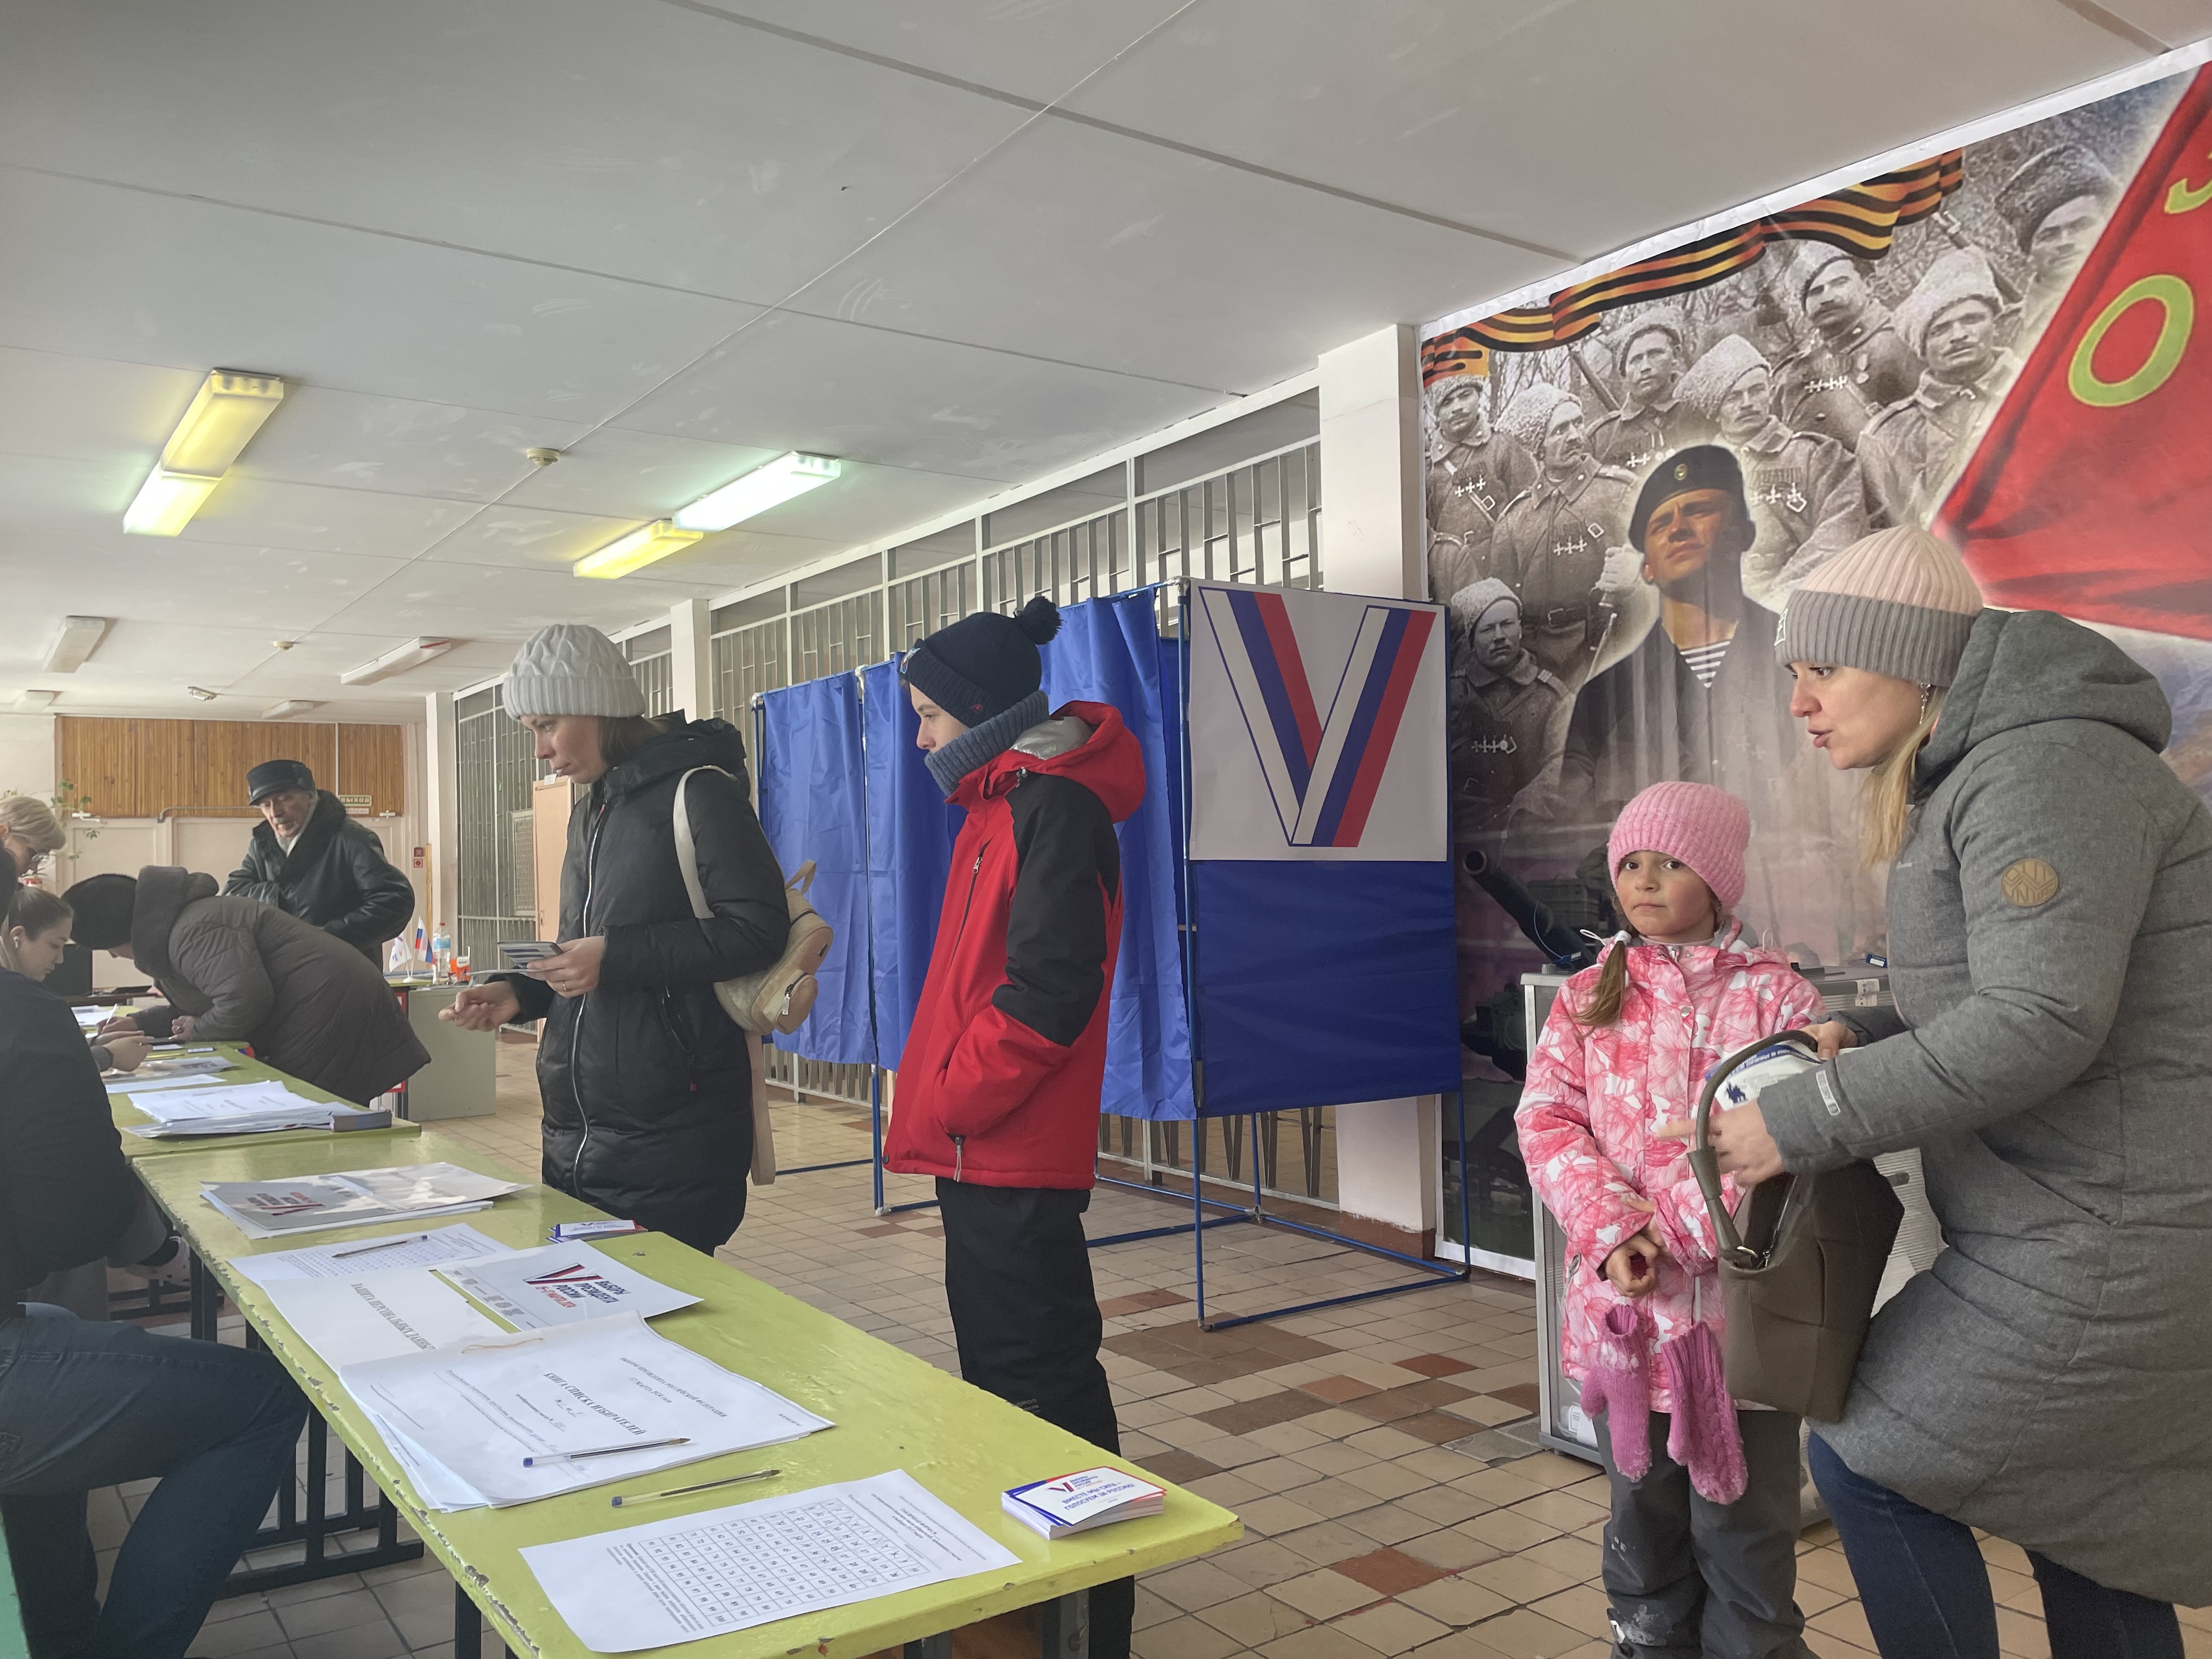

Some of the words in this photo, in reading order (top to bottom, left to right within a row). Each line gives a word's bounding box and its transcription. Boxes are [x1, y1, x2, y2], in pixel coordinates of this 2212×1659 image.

[1198, 586, 1437, 847] V
[553, 1285, 586, 1298] РОССИИ
[574, 1283, 620, 1303] ПРЕЗИДЕНТА
[595, 1281, 631, 1295] ВЫБОРЫ
[351, 1283, 375, 1301] ЗАЩИТА
[368, 1300, 415, 1333] ПЕРСОНАЛЬНЫХ
[637, 1366, 667, 1384] ПРЕЗИДЕНТА
[664, 1383, 699, 1401] РОССИЙСКОЙ
[696, 1399, 727, 1418] ФЕДЕРАЦИИ
[544, 1373, 568, 1387] КНИГА
[565, 1385, 595, 1406] СПИСКА
[591, 1404, 647, 1435] ИЗБИРАТЕЛЕЙ
[1062, 1492, 1088, 1504] ВМЕСТЕ
[1087, 1487, 1101, 1496] МЫ
[1099, 1483, 1118, 1492] СИЛА
[1064, 1494, 1098, 1510] ГОЛОСУЕМ
